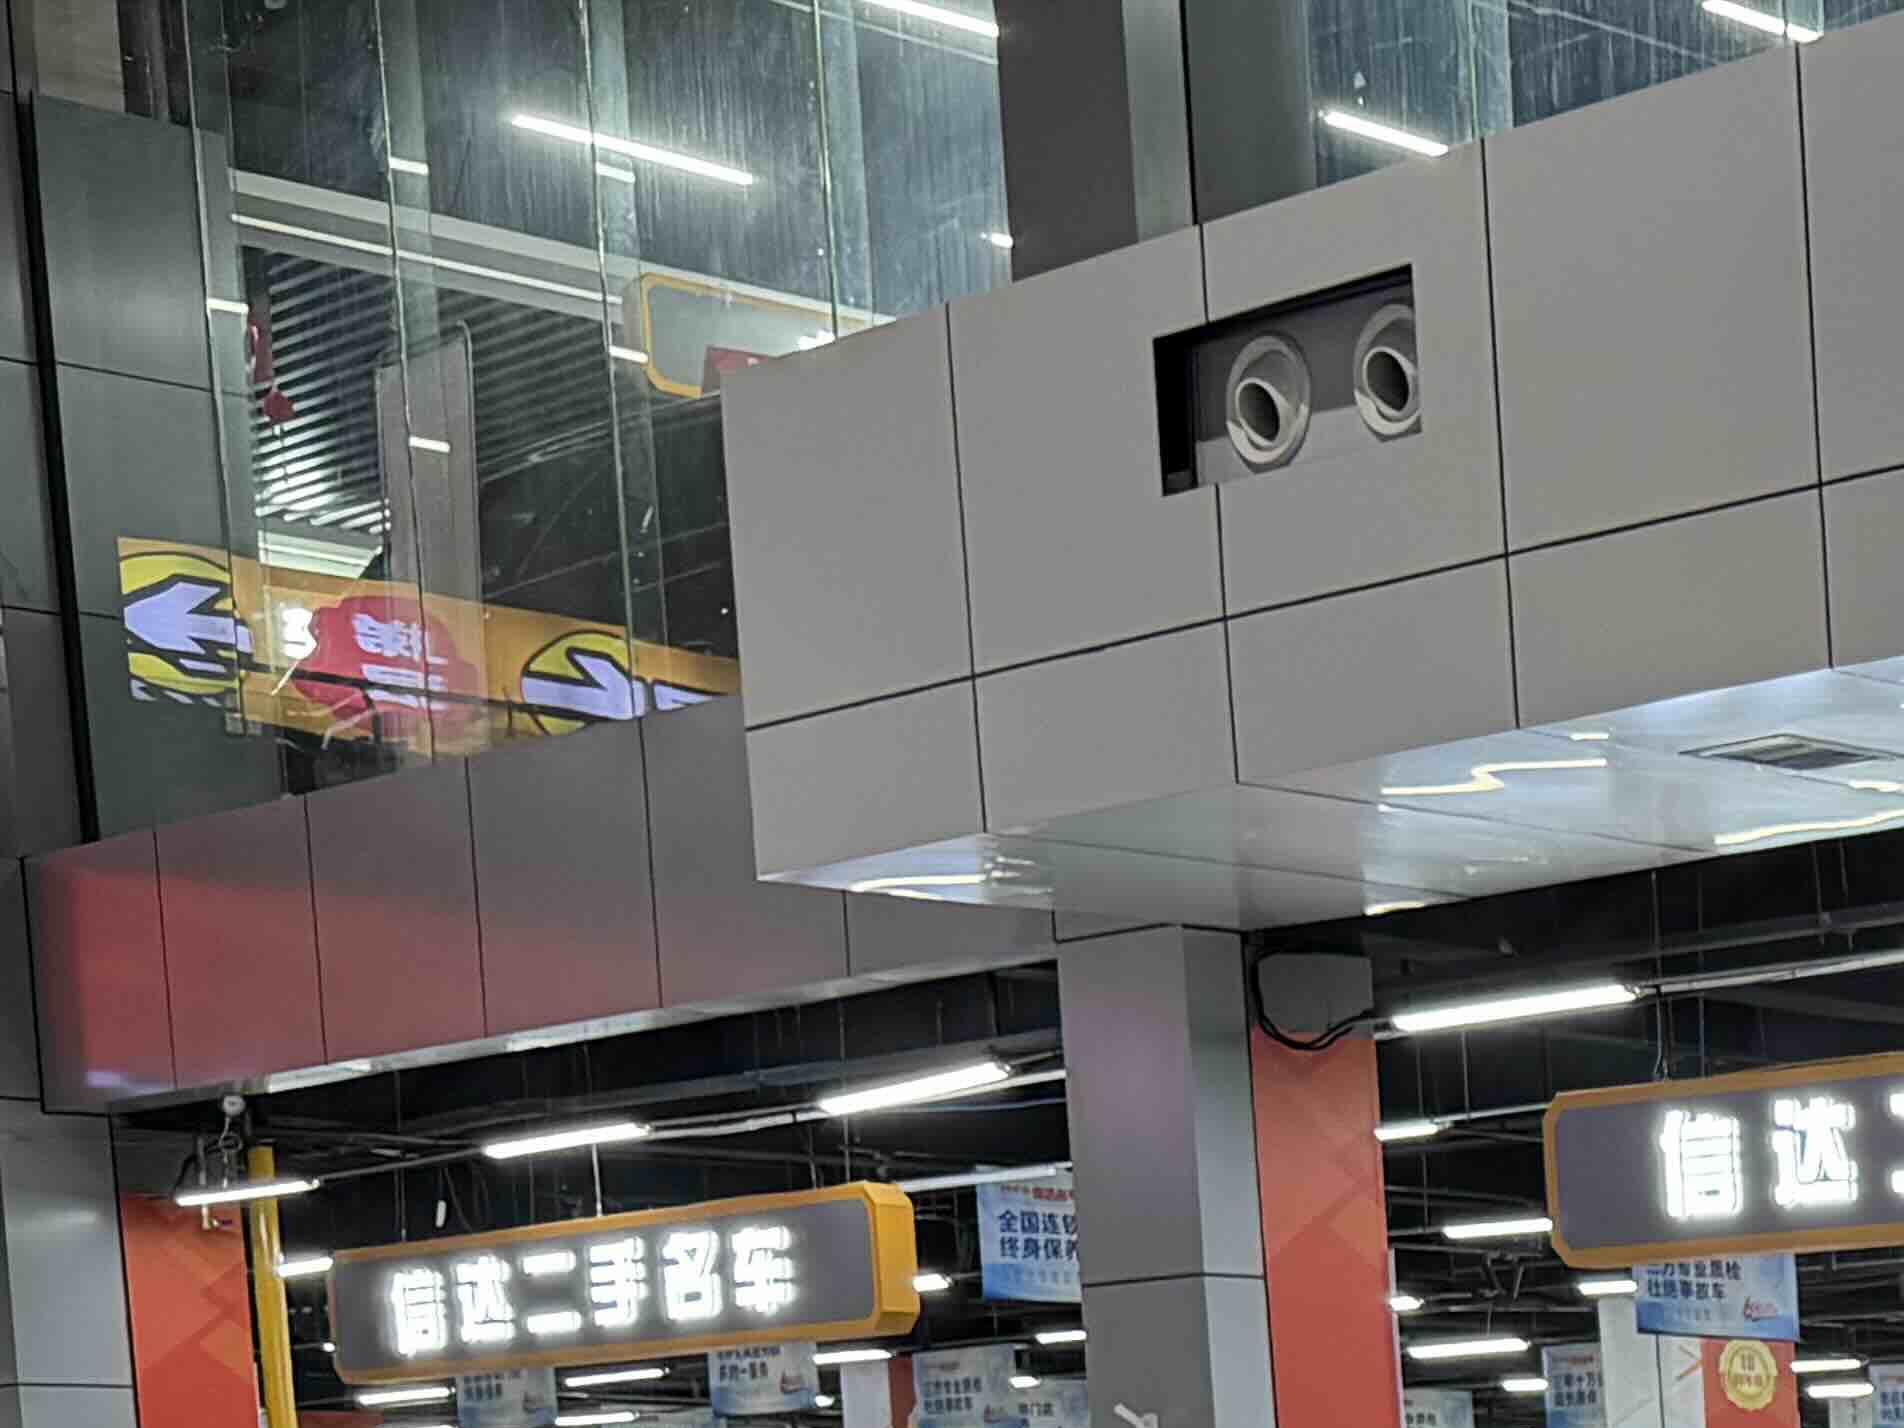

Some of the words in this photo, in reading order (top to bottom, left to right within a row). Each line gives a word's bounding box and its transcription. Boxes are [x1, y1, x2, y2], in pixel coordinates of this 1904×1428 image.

[393, 1223, 796, 1356] 信达二手名车
